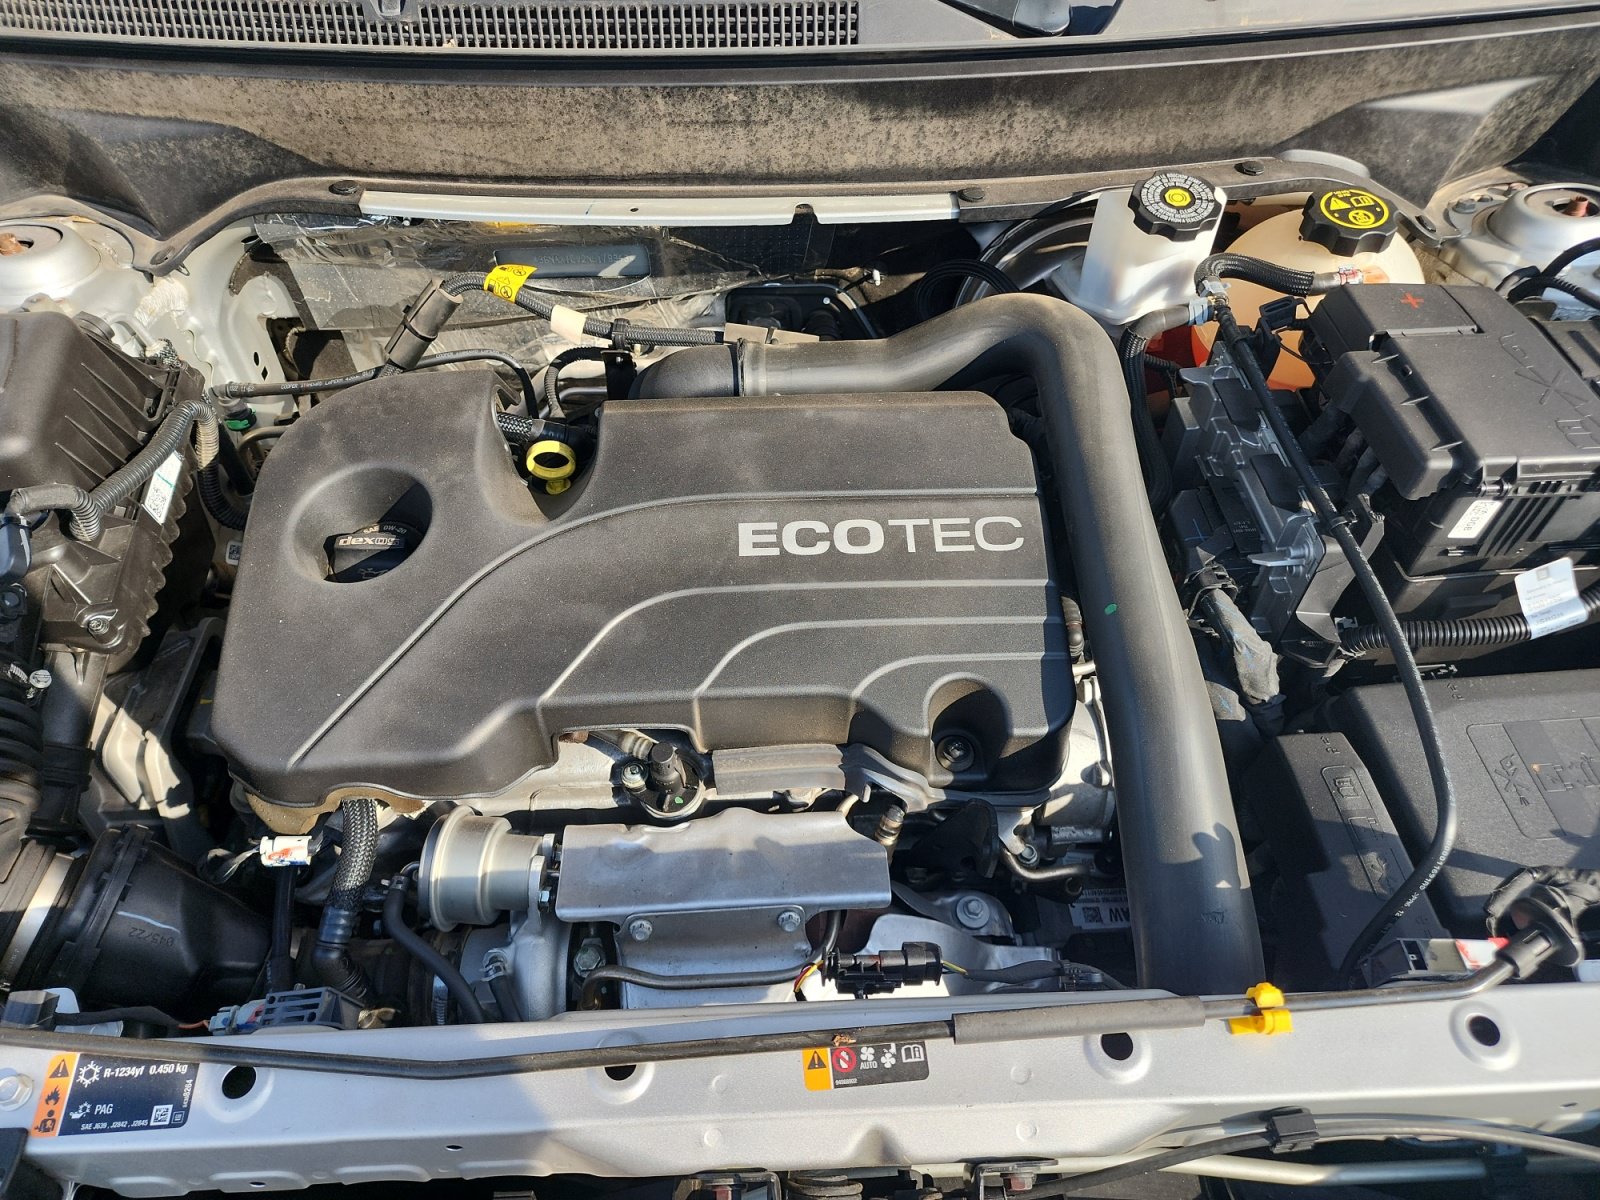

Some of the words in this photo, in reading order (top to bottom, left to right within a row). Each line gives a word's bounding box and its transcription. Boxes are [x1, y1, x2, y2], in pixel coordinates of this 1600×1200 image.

[383, 525, 408, 535] 0W-20
[338, 535, 400, 546] dexos
[738, 516, 1025, 556] ECOTEC
[104, 1066, 143, 1077] R-1234yf
[149, 1064, 174, 1074] 0.450
[175, 1063, 188, 1073] kg
[860, 1061, 878, 1070] AUTO
[94, 1104, 113, 1114] PAG
